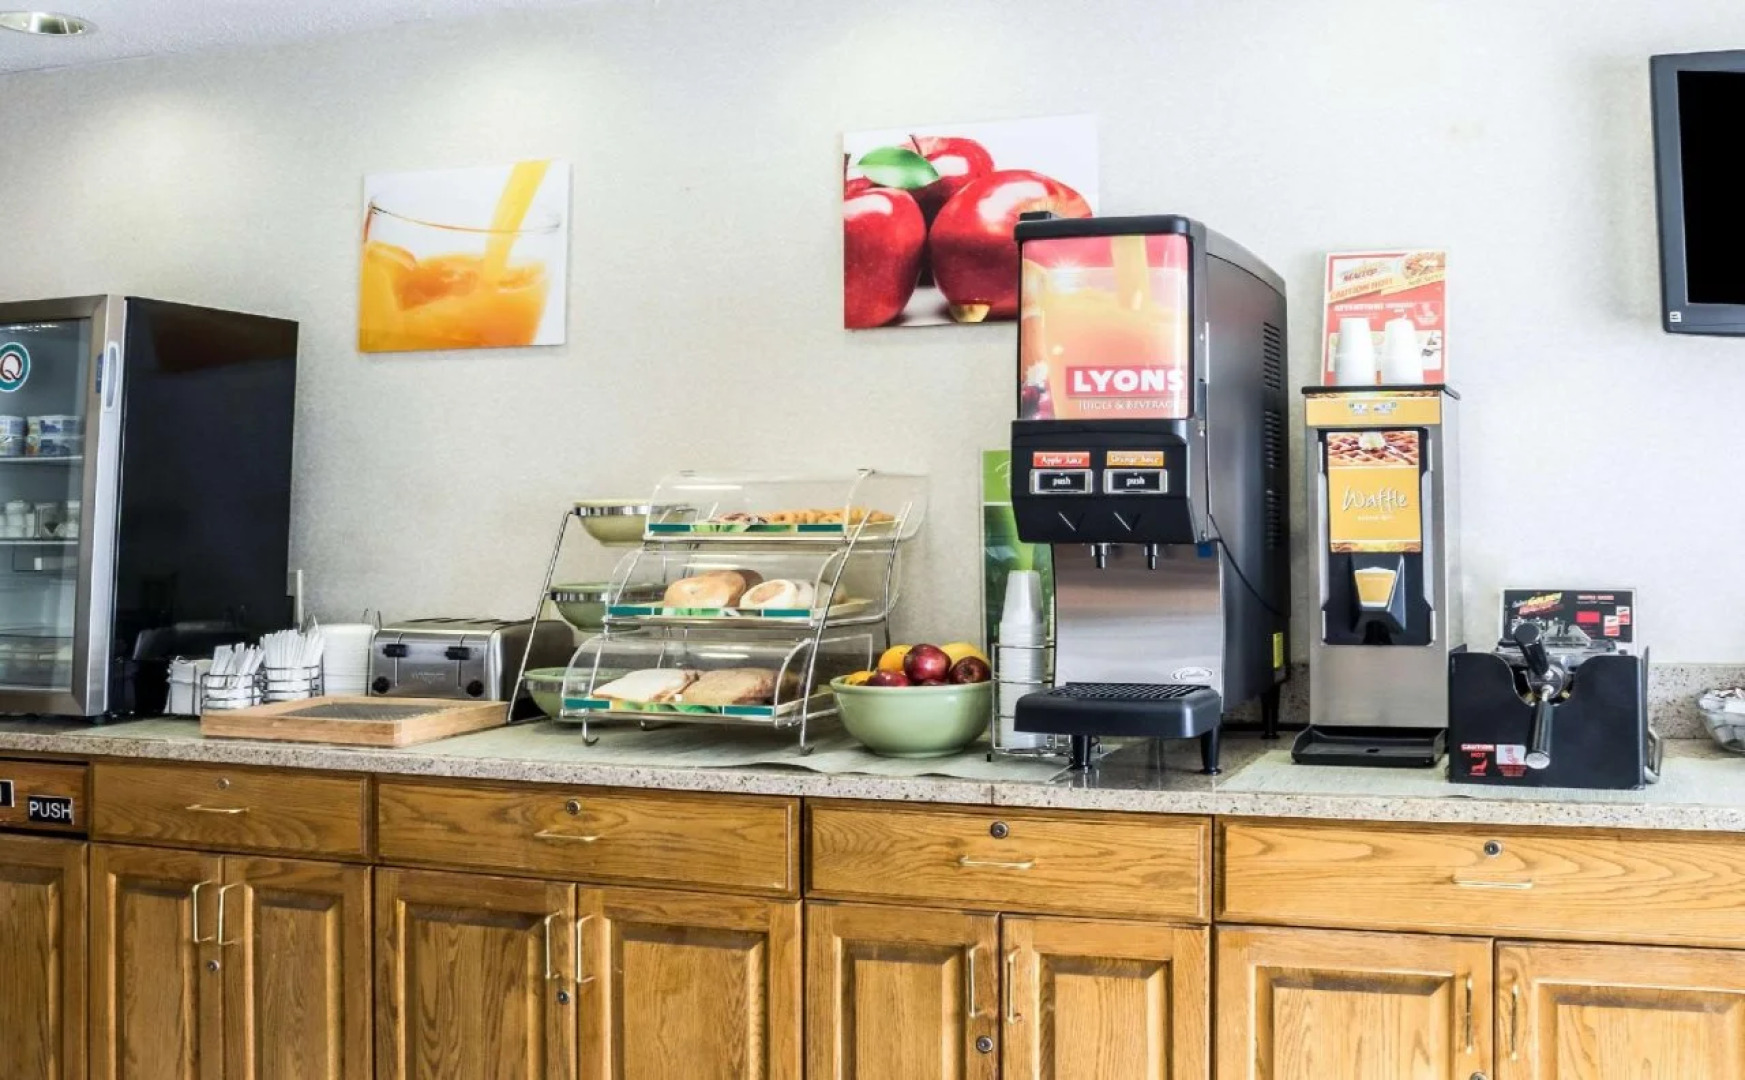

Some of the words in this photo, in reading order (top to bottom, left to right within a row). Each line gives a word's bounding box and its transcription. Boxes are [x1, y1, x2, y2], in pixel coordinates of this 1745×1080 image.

[1074, 370, 1184, 392] LYONS
[1041, 454, 1062, 467] Apple
[1052, 475, 1071, 486] push
[1126, 475, 1145, 486] push
[1343, 486, 1408, 512] Waffle
[29, 801, 72, 819] PUSH
